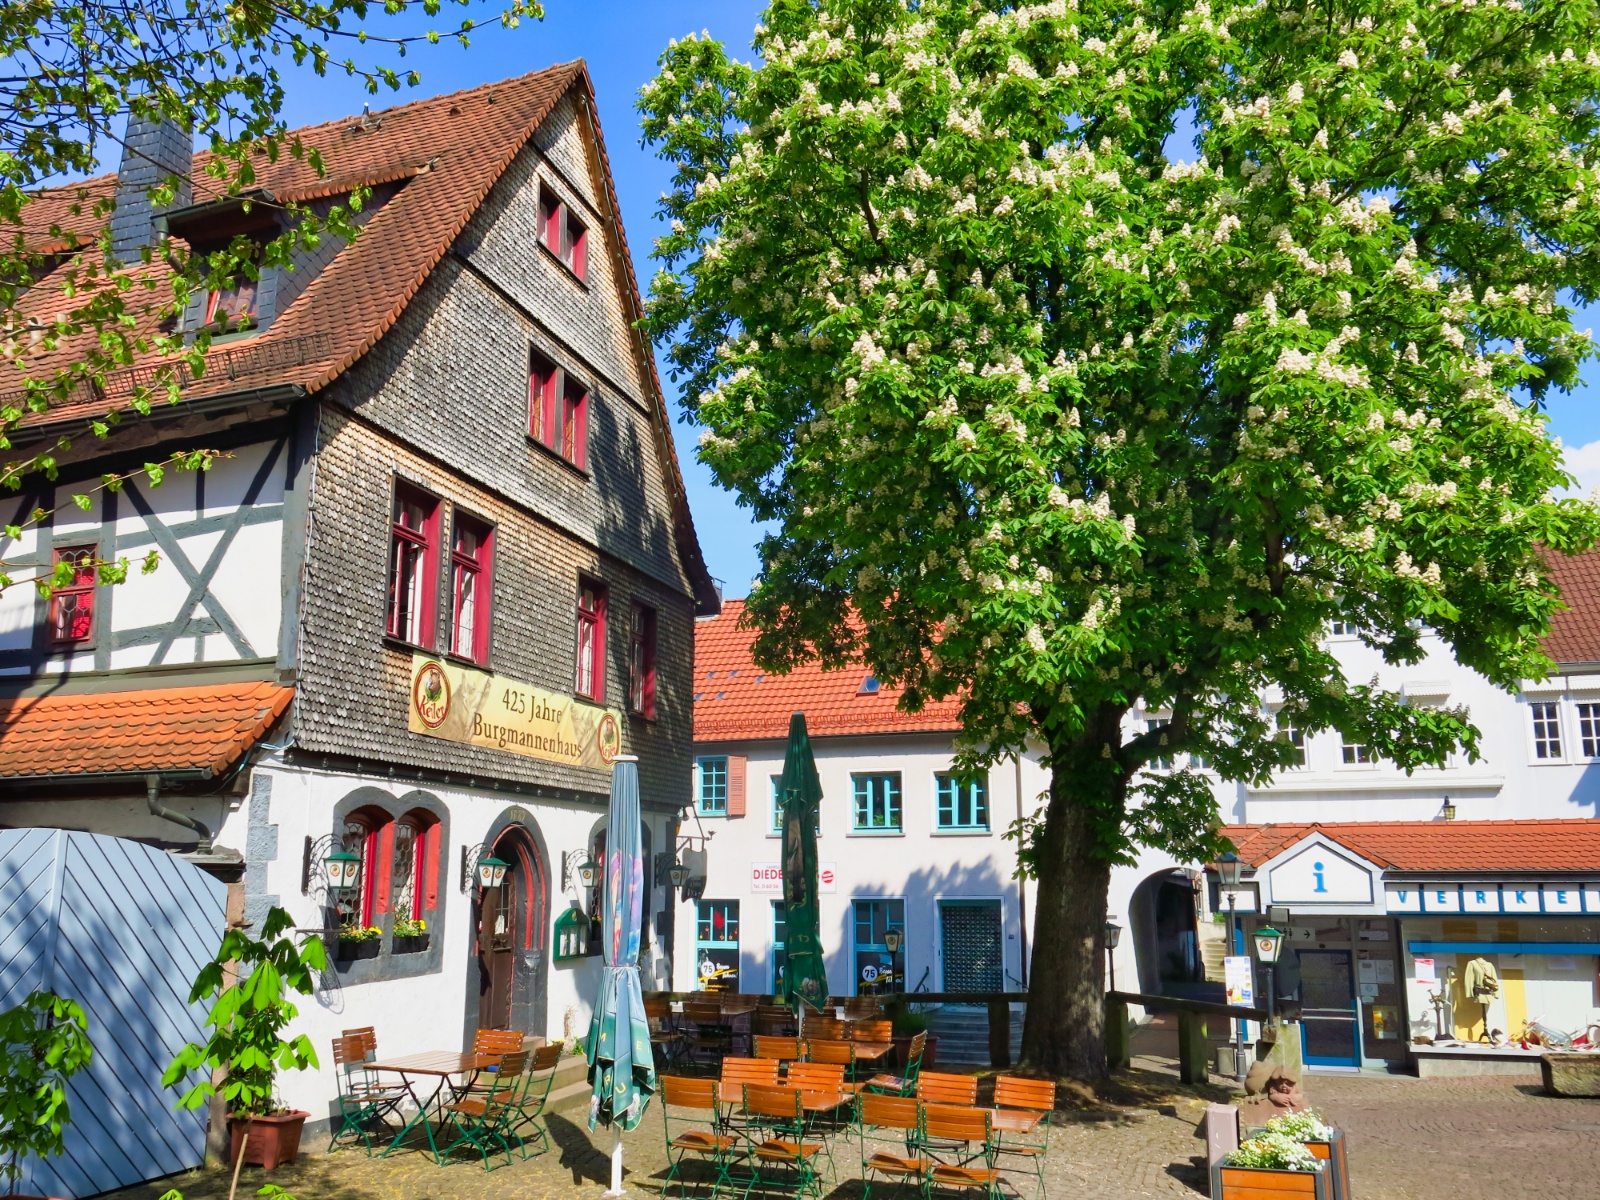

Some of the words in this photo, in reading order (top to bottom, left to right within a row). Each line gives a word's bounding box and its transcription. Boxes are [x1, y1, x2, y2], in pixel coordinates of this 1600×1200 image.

[419, 694, 445, 720] Keiler
[502, 688, 526, 714] 425
[528, 695, 563, 724] Jahre
[473, 711, 583, 758] Burgmannenhaus
[1397, 890, 1600, 904] VERKE
[704, 965, 713, 973] 75
[865, 969, 875, 978] 75
